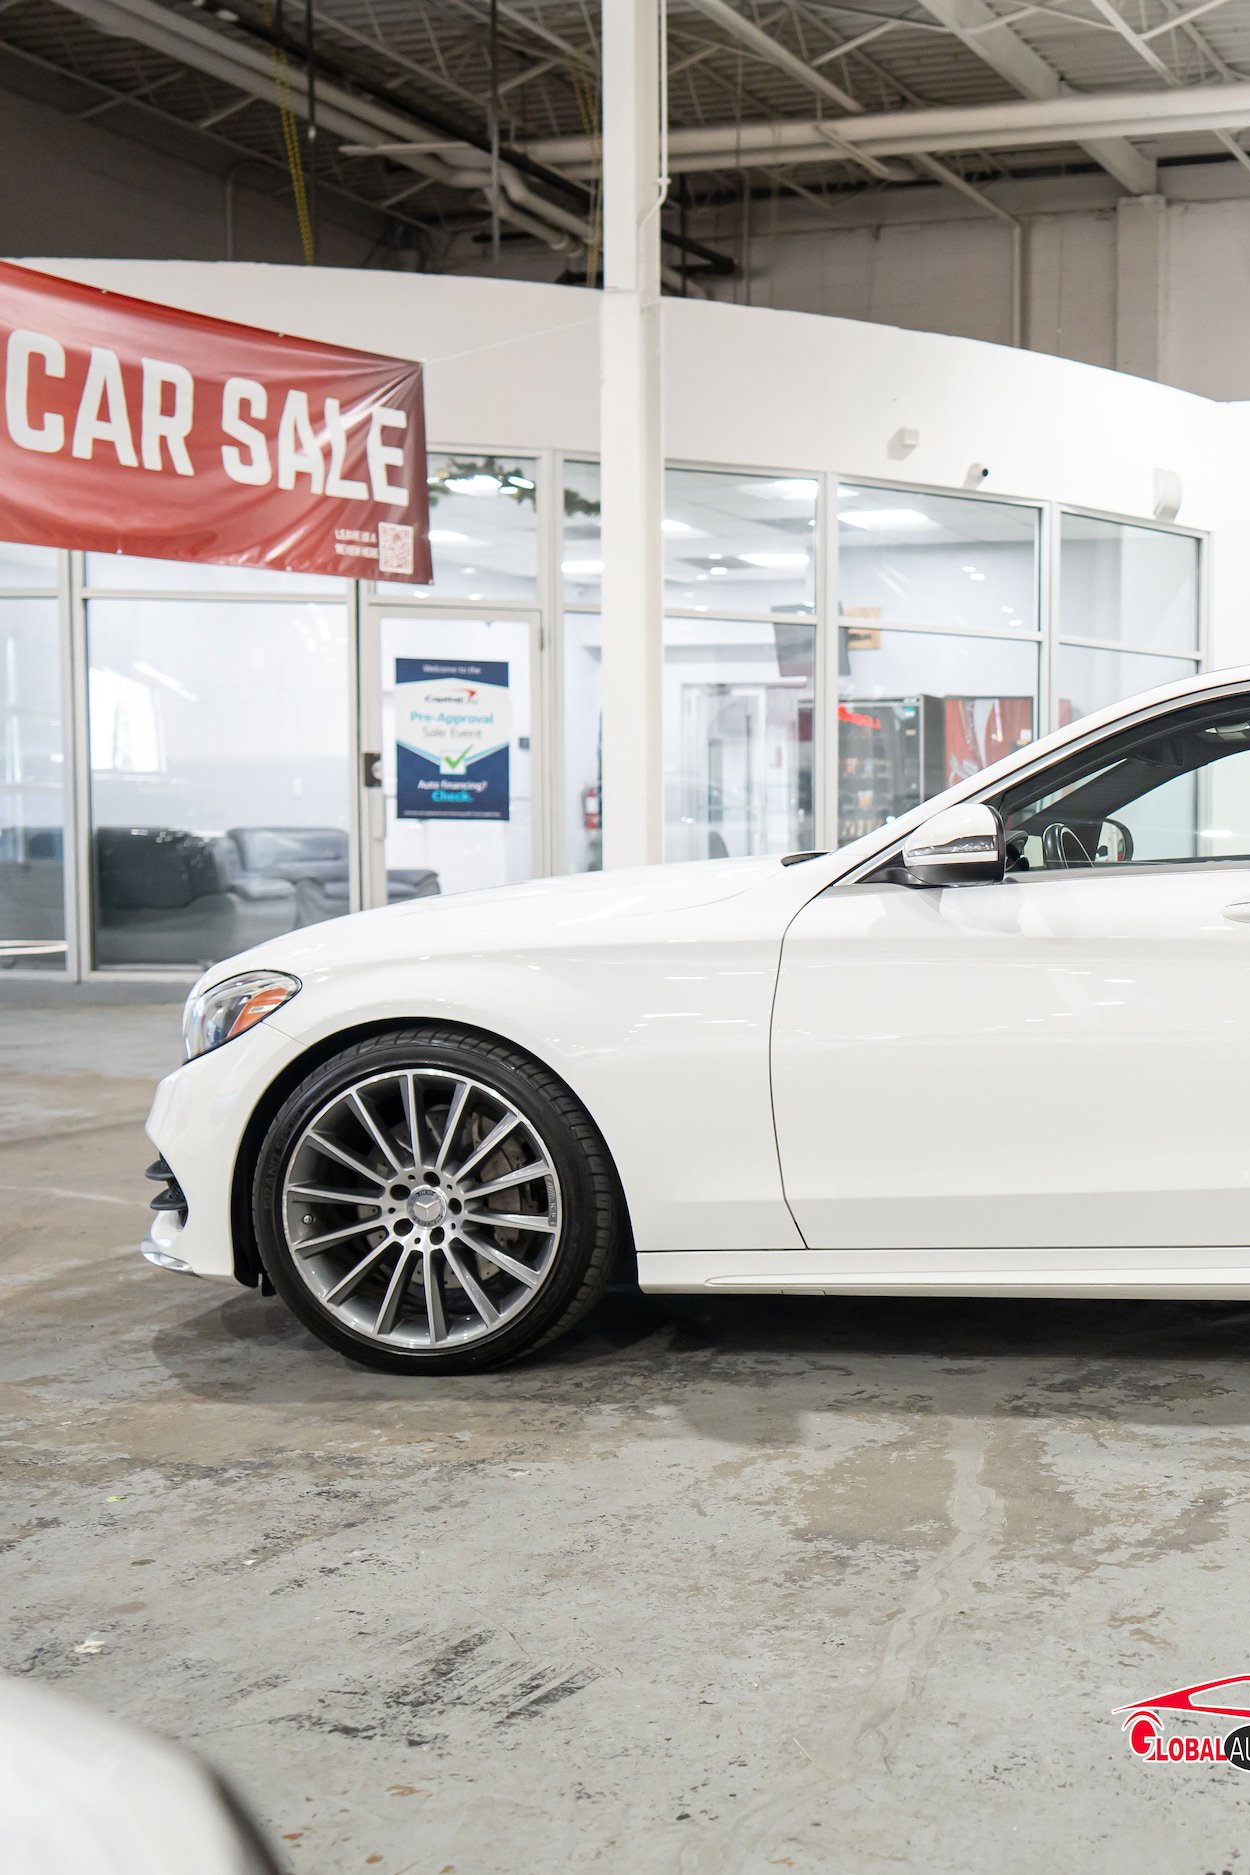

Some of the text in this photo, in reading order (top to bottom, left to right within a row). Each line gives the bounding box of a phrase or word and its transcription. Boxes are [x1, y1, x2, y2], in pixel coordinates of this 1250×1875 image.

[5, 329, 409, 507] CAR SALE
[410, 711, 494, 724] Pre-Approval
[422, 726, 482, 738] Sale Event
[417, 779, 488, 793] Auto financing?
